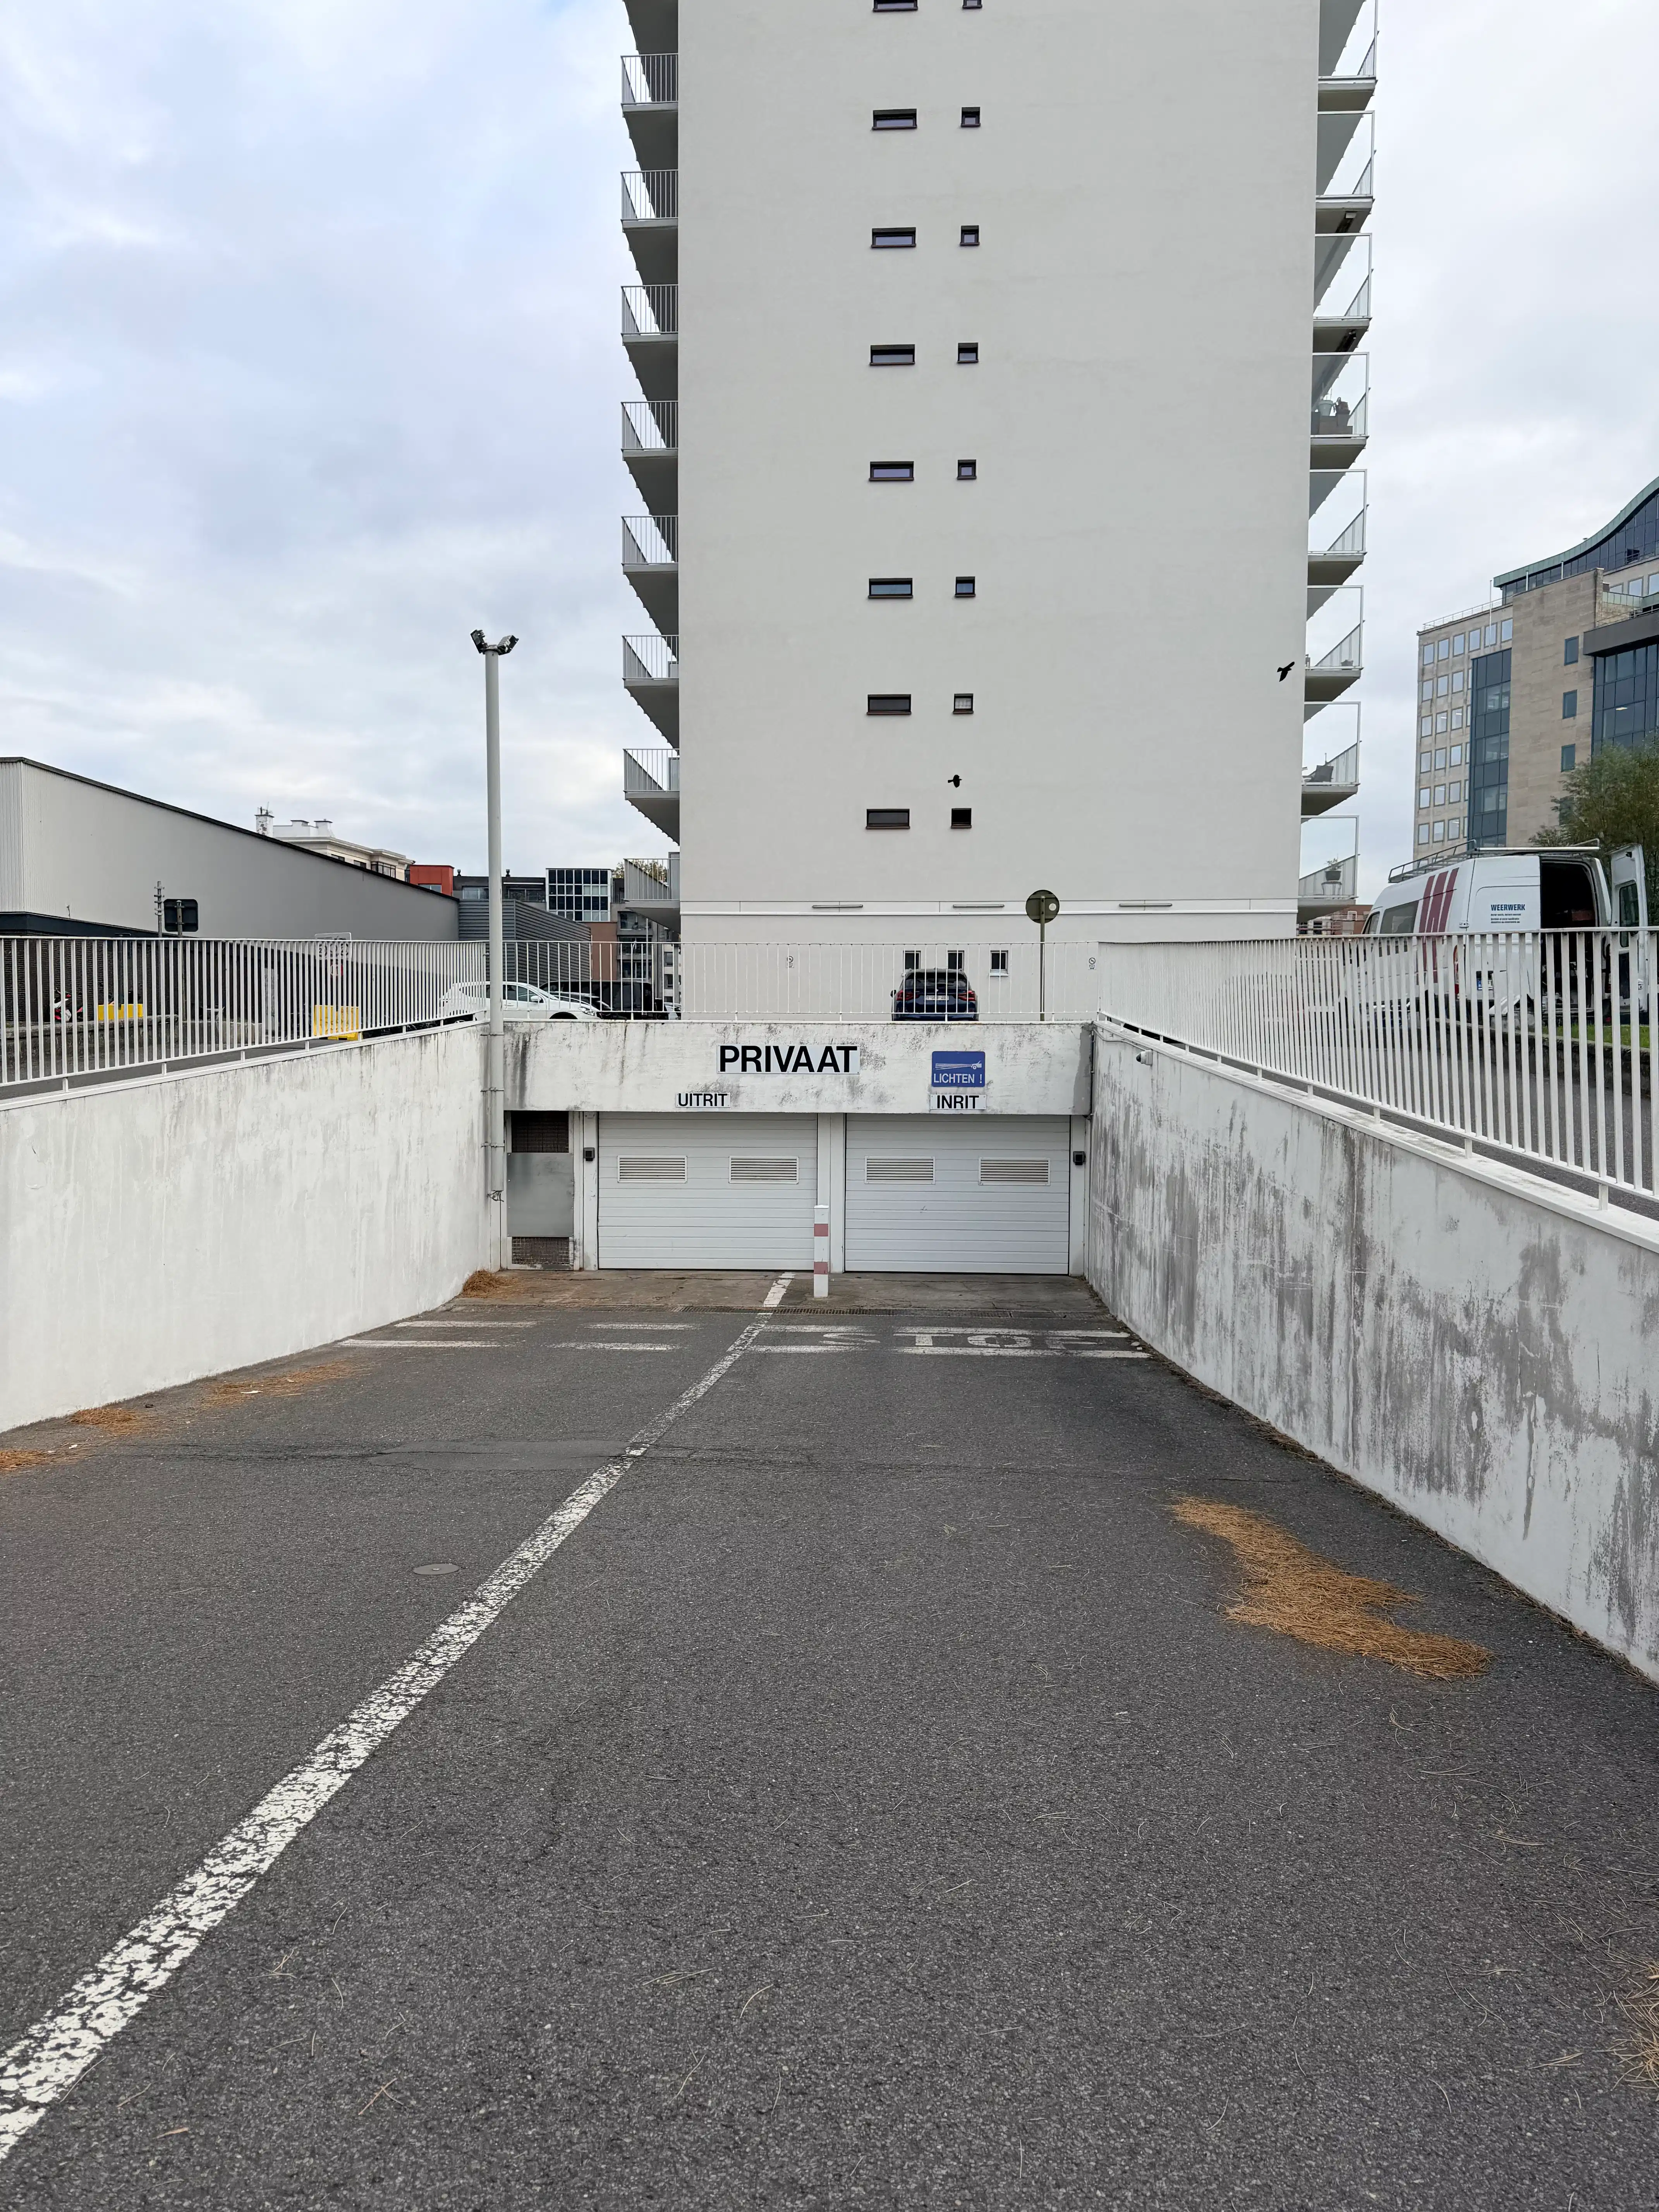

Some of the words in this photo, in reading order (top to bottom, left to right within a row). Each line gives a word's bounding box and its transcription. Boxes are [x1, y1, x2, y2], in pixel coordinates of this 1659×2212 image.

[720, 1045, 857, 1072] PRIVAAT
[934, 1073, 975, 1084] LICHTEN
[678, 1093, 728, 1106] UITRIT
[937, 1095, 979, 1109] INRIT
[817, 1332, 1104, 1350] STOP
